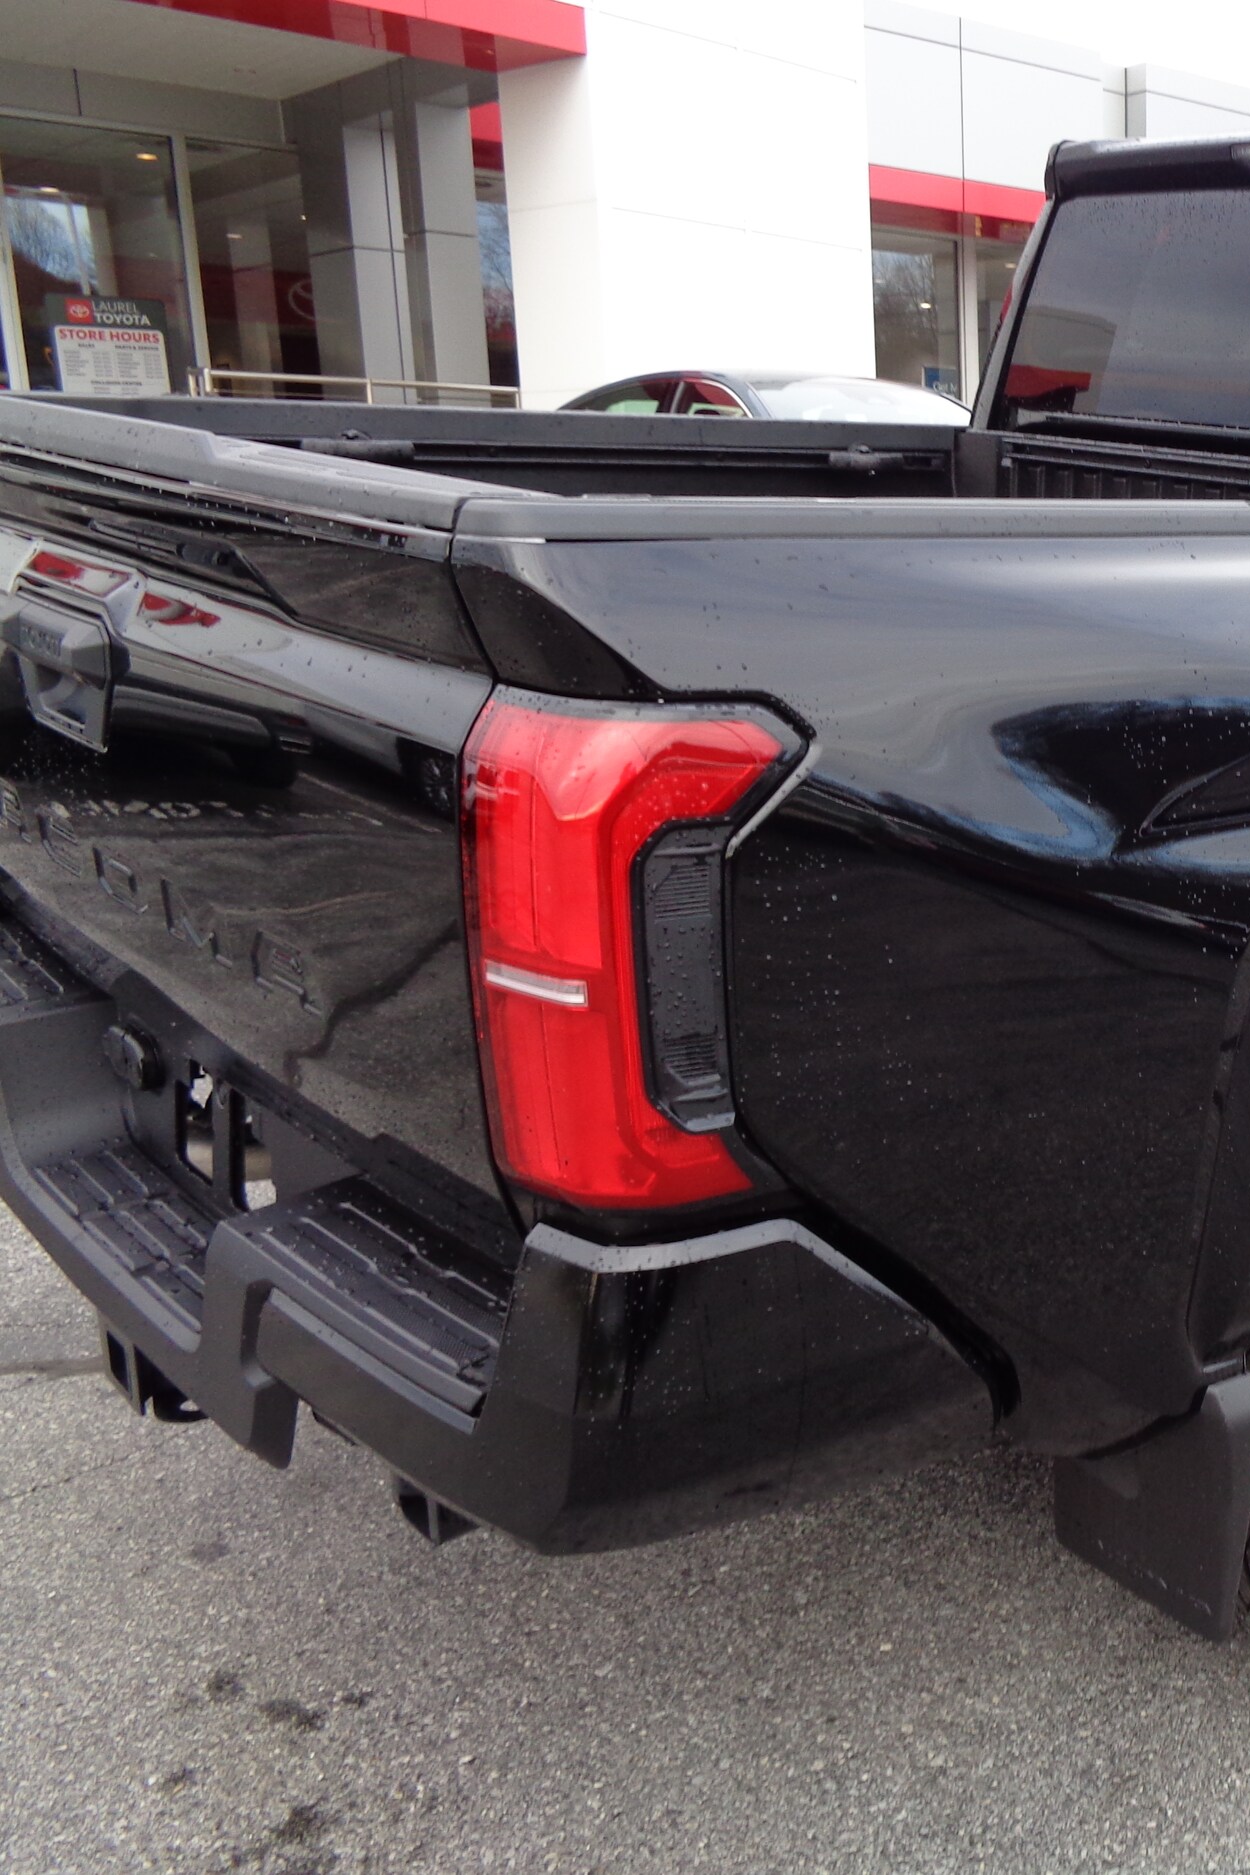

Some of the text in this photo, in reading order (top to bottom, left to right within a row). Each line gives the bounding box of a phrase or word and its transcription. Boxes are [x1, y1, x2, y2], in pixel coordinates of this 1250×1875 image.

[92, 301, 138, 314] LAUREL
[96, 314, 151, 326] TOYOTA
[59, 328, 160, 343] STORE HOURS
